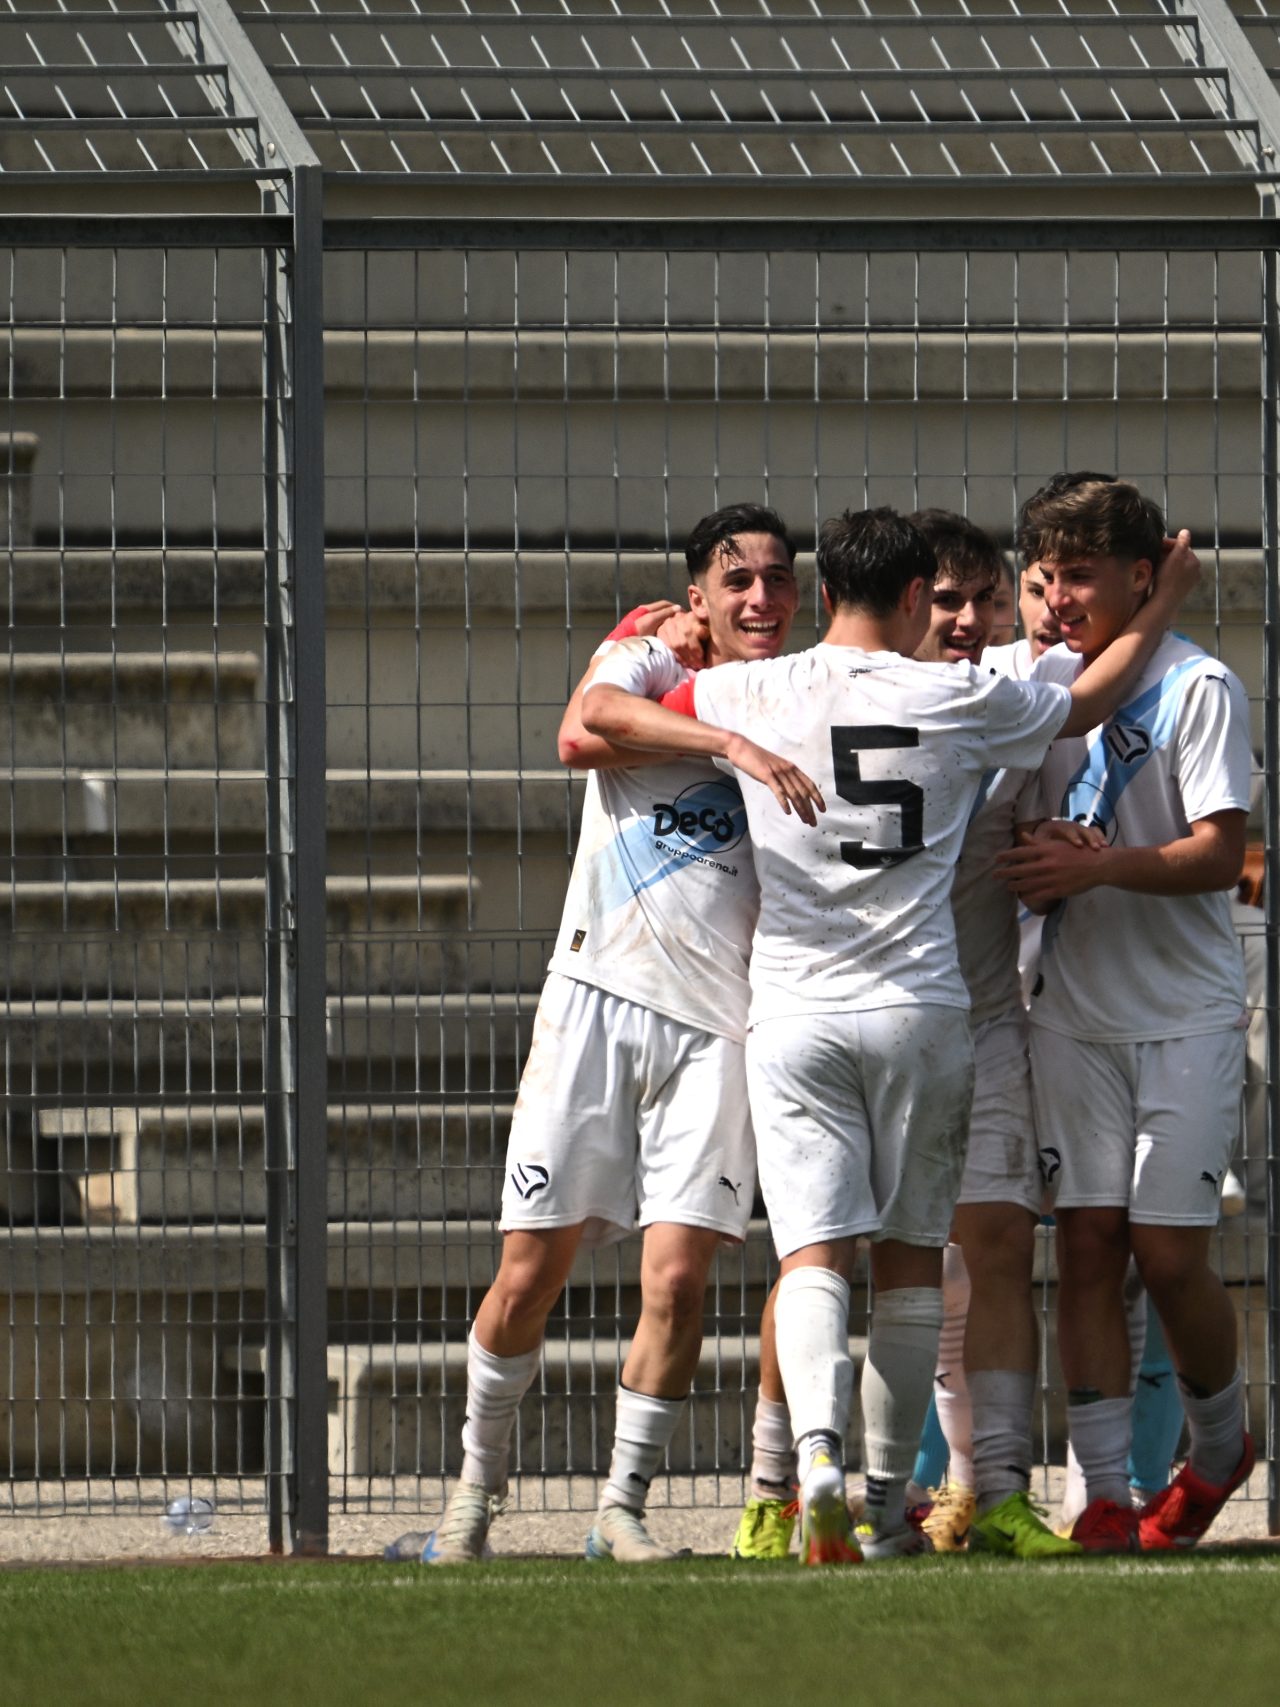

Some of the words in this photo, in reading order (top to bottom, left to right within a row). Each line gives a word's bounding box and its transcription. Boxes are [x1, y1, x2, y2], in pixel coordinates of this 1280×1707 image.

[831, 725, 925, 870] 5
[652, 803, 735, 843] Decò
[655, 840, 738, 877] gruppoarena.it
